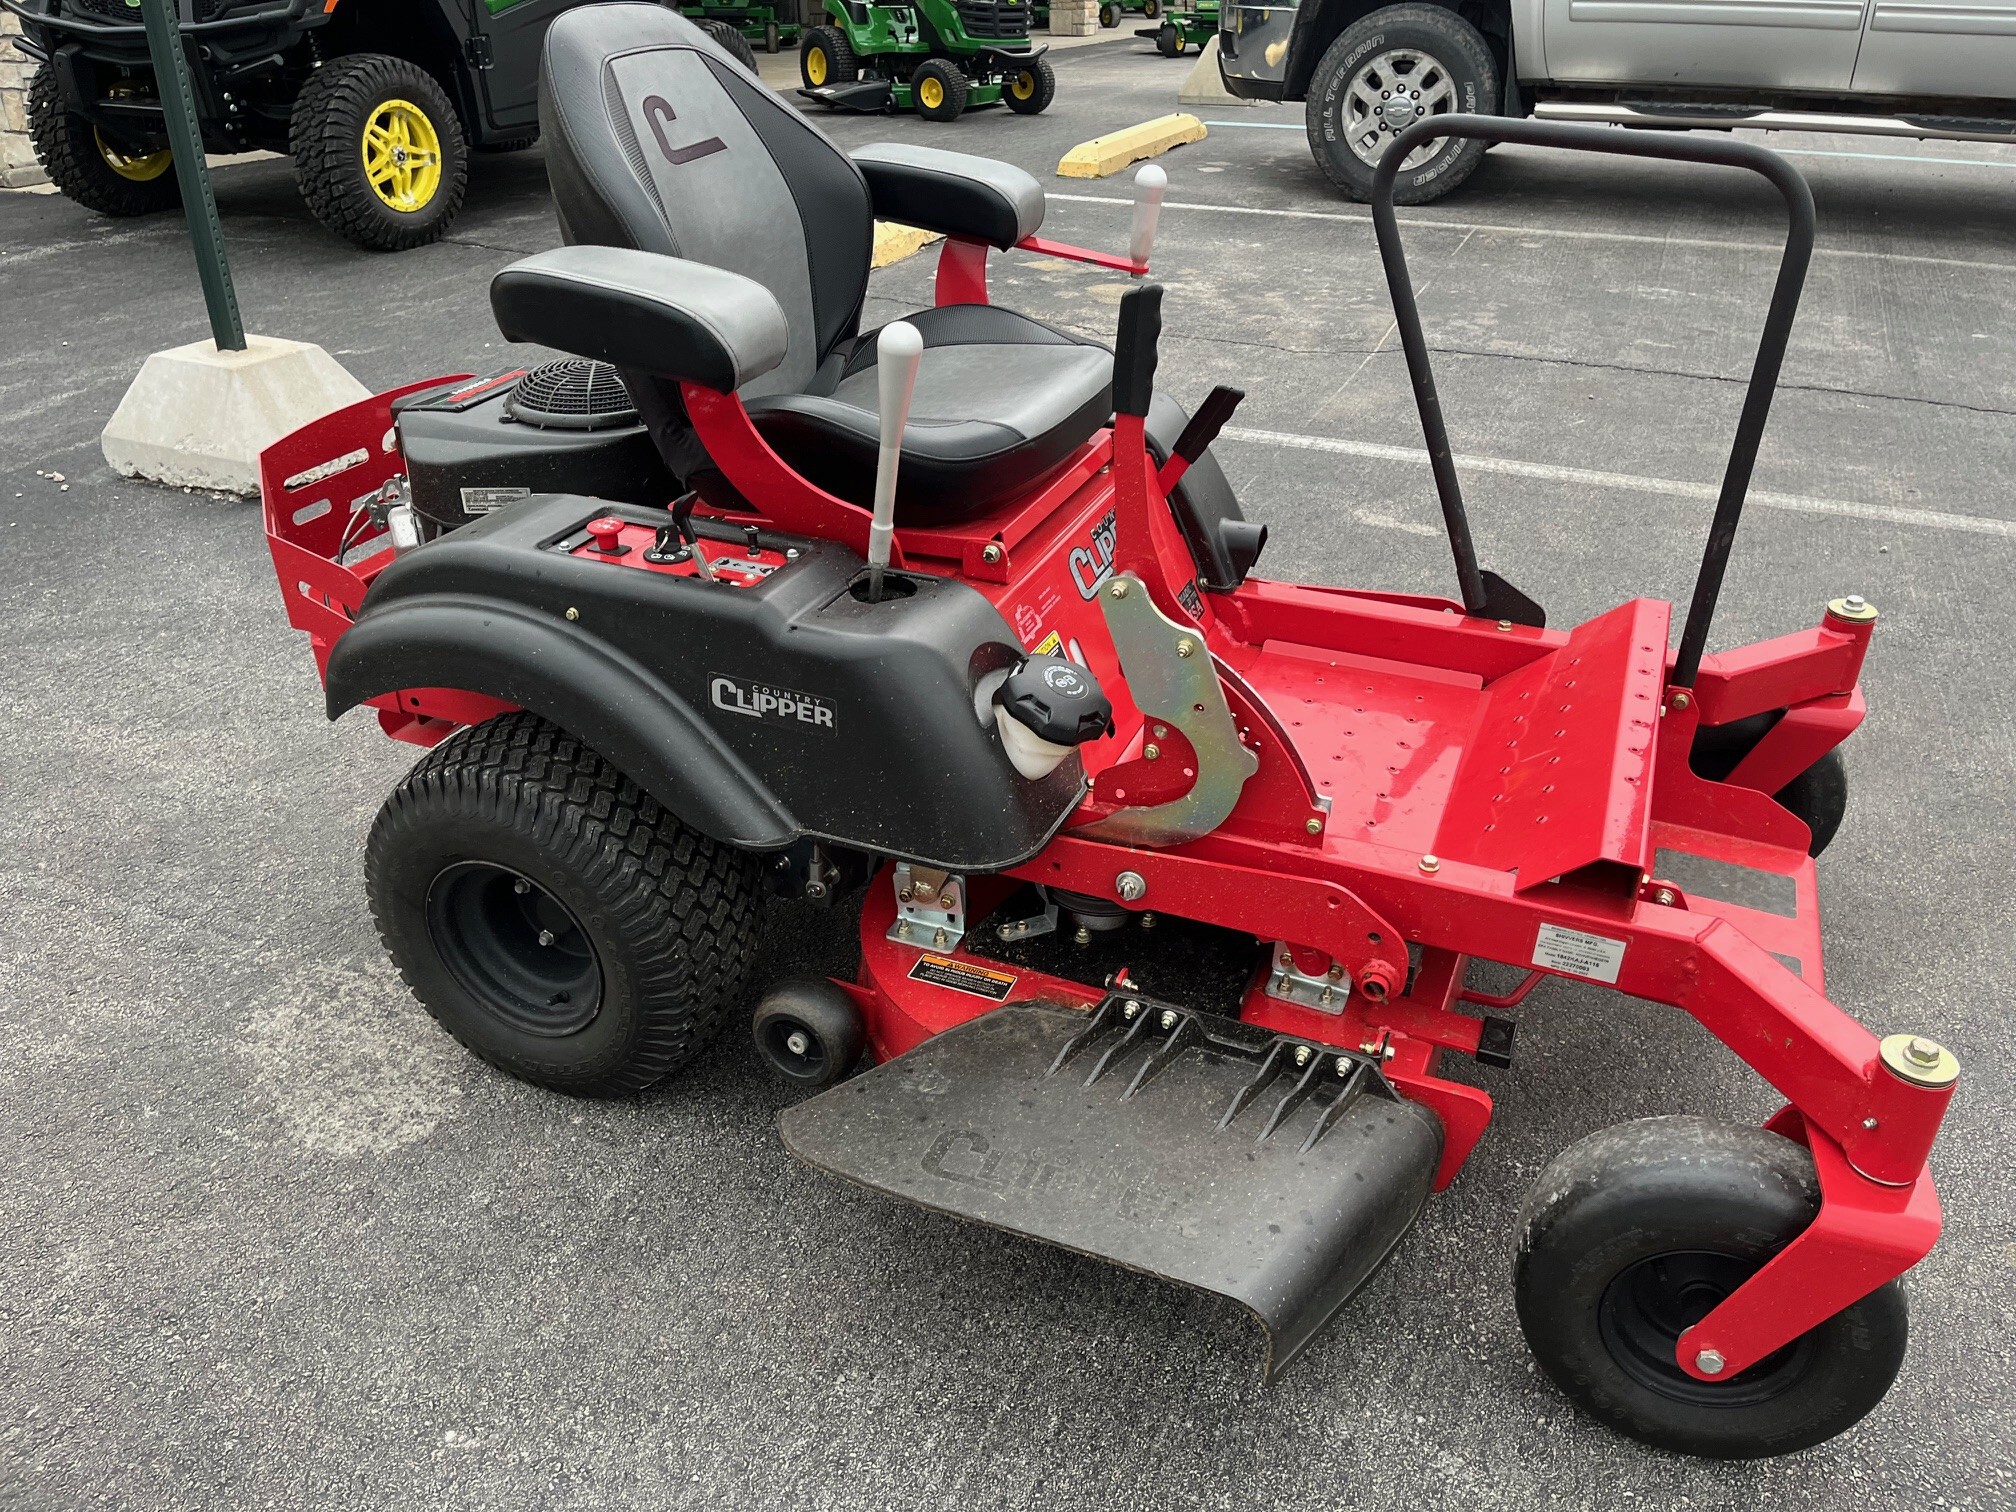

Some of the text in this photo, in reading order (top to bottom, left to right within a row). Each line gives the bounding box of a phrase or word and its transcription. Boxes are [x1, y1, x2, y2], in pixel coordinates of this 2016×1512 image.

[1323, 34, 1385, 142] ALL TERRAIN
[1069, 519, 1117, 602] CLIP
[711, 678, 833, 728] CLIPPER
[752, 685, 821, 706] COUNTRY
[953, 964, 990, 976] WARNING
